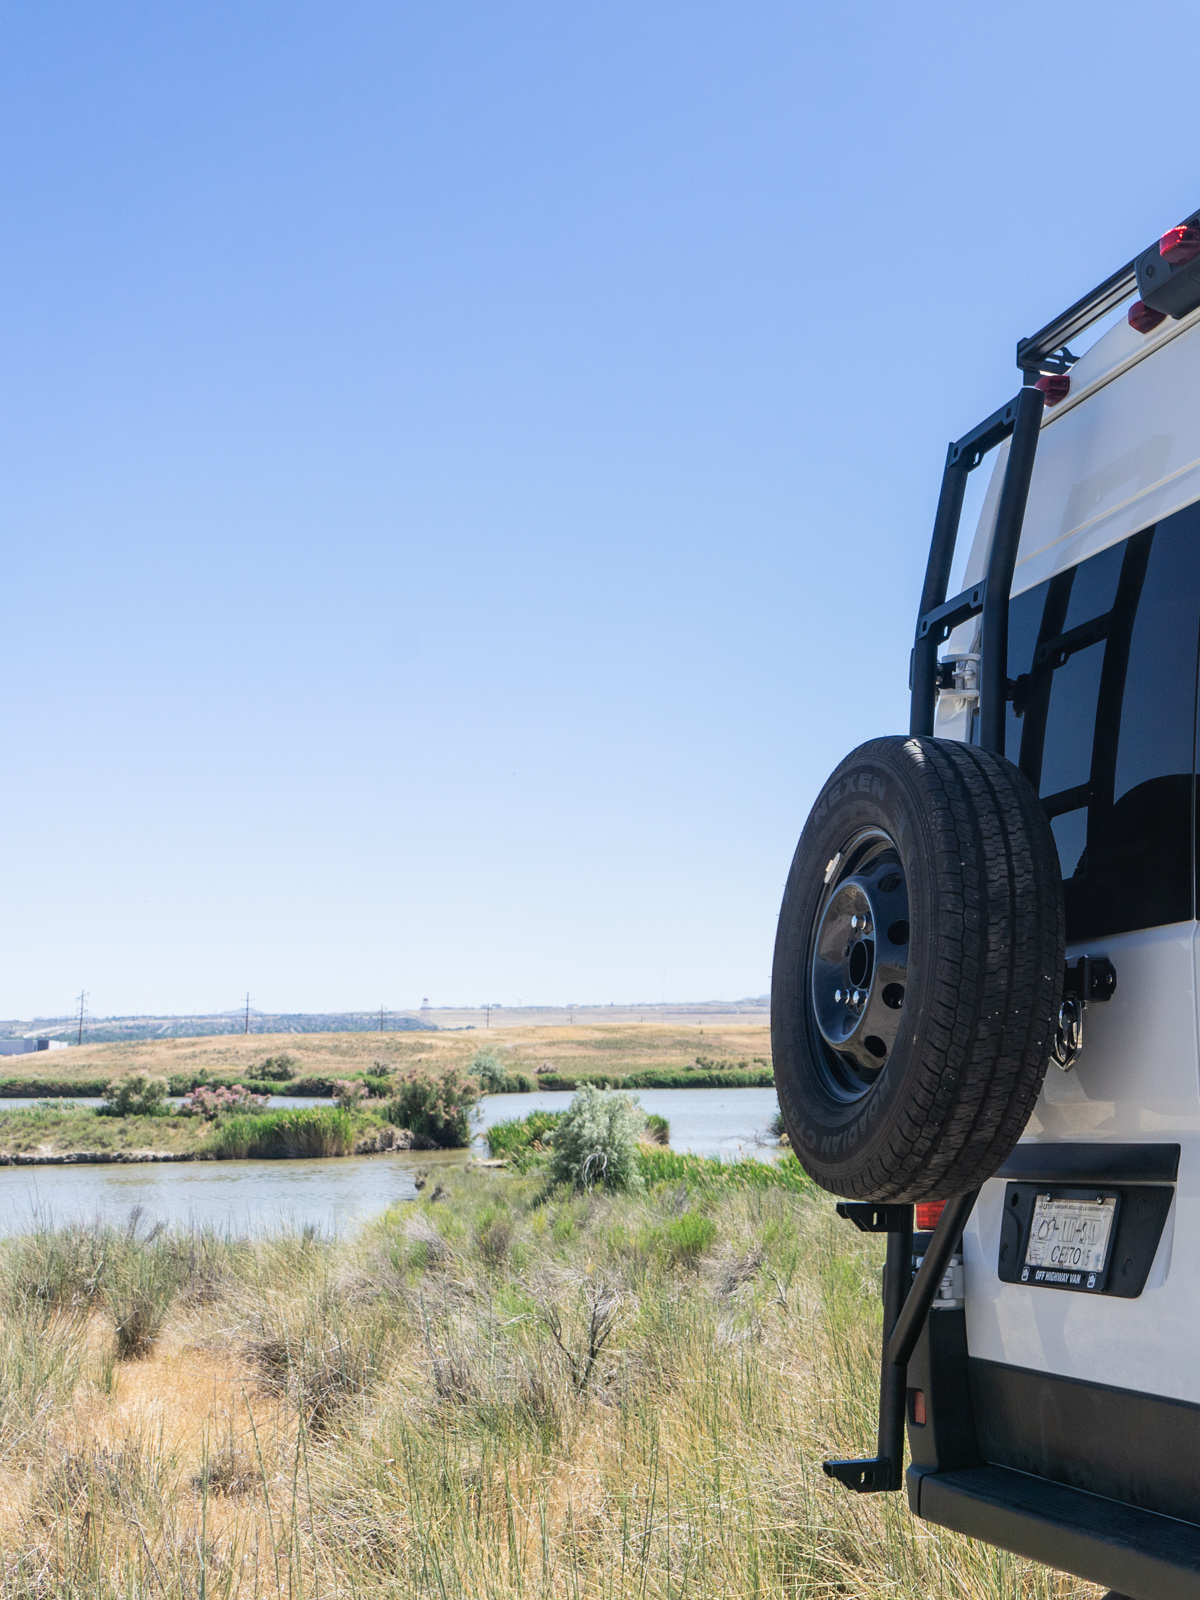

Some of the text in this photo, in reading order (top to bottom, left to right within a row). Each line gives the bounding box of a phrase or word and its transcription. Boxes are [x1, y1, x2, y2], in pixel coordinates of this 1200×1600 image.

[813, 773, 887, 826] NEXEN
[821, 1069, 891, 1155] ROADIAN
[1035, 1270, 1045, 1281] OFF
[1045, 1271, 1070, 1284] HIGHWAY
[1069, 1273, 1082, 1285] VAN
